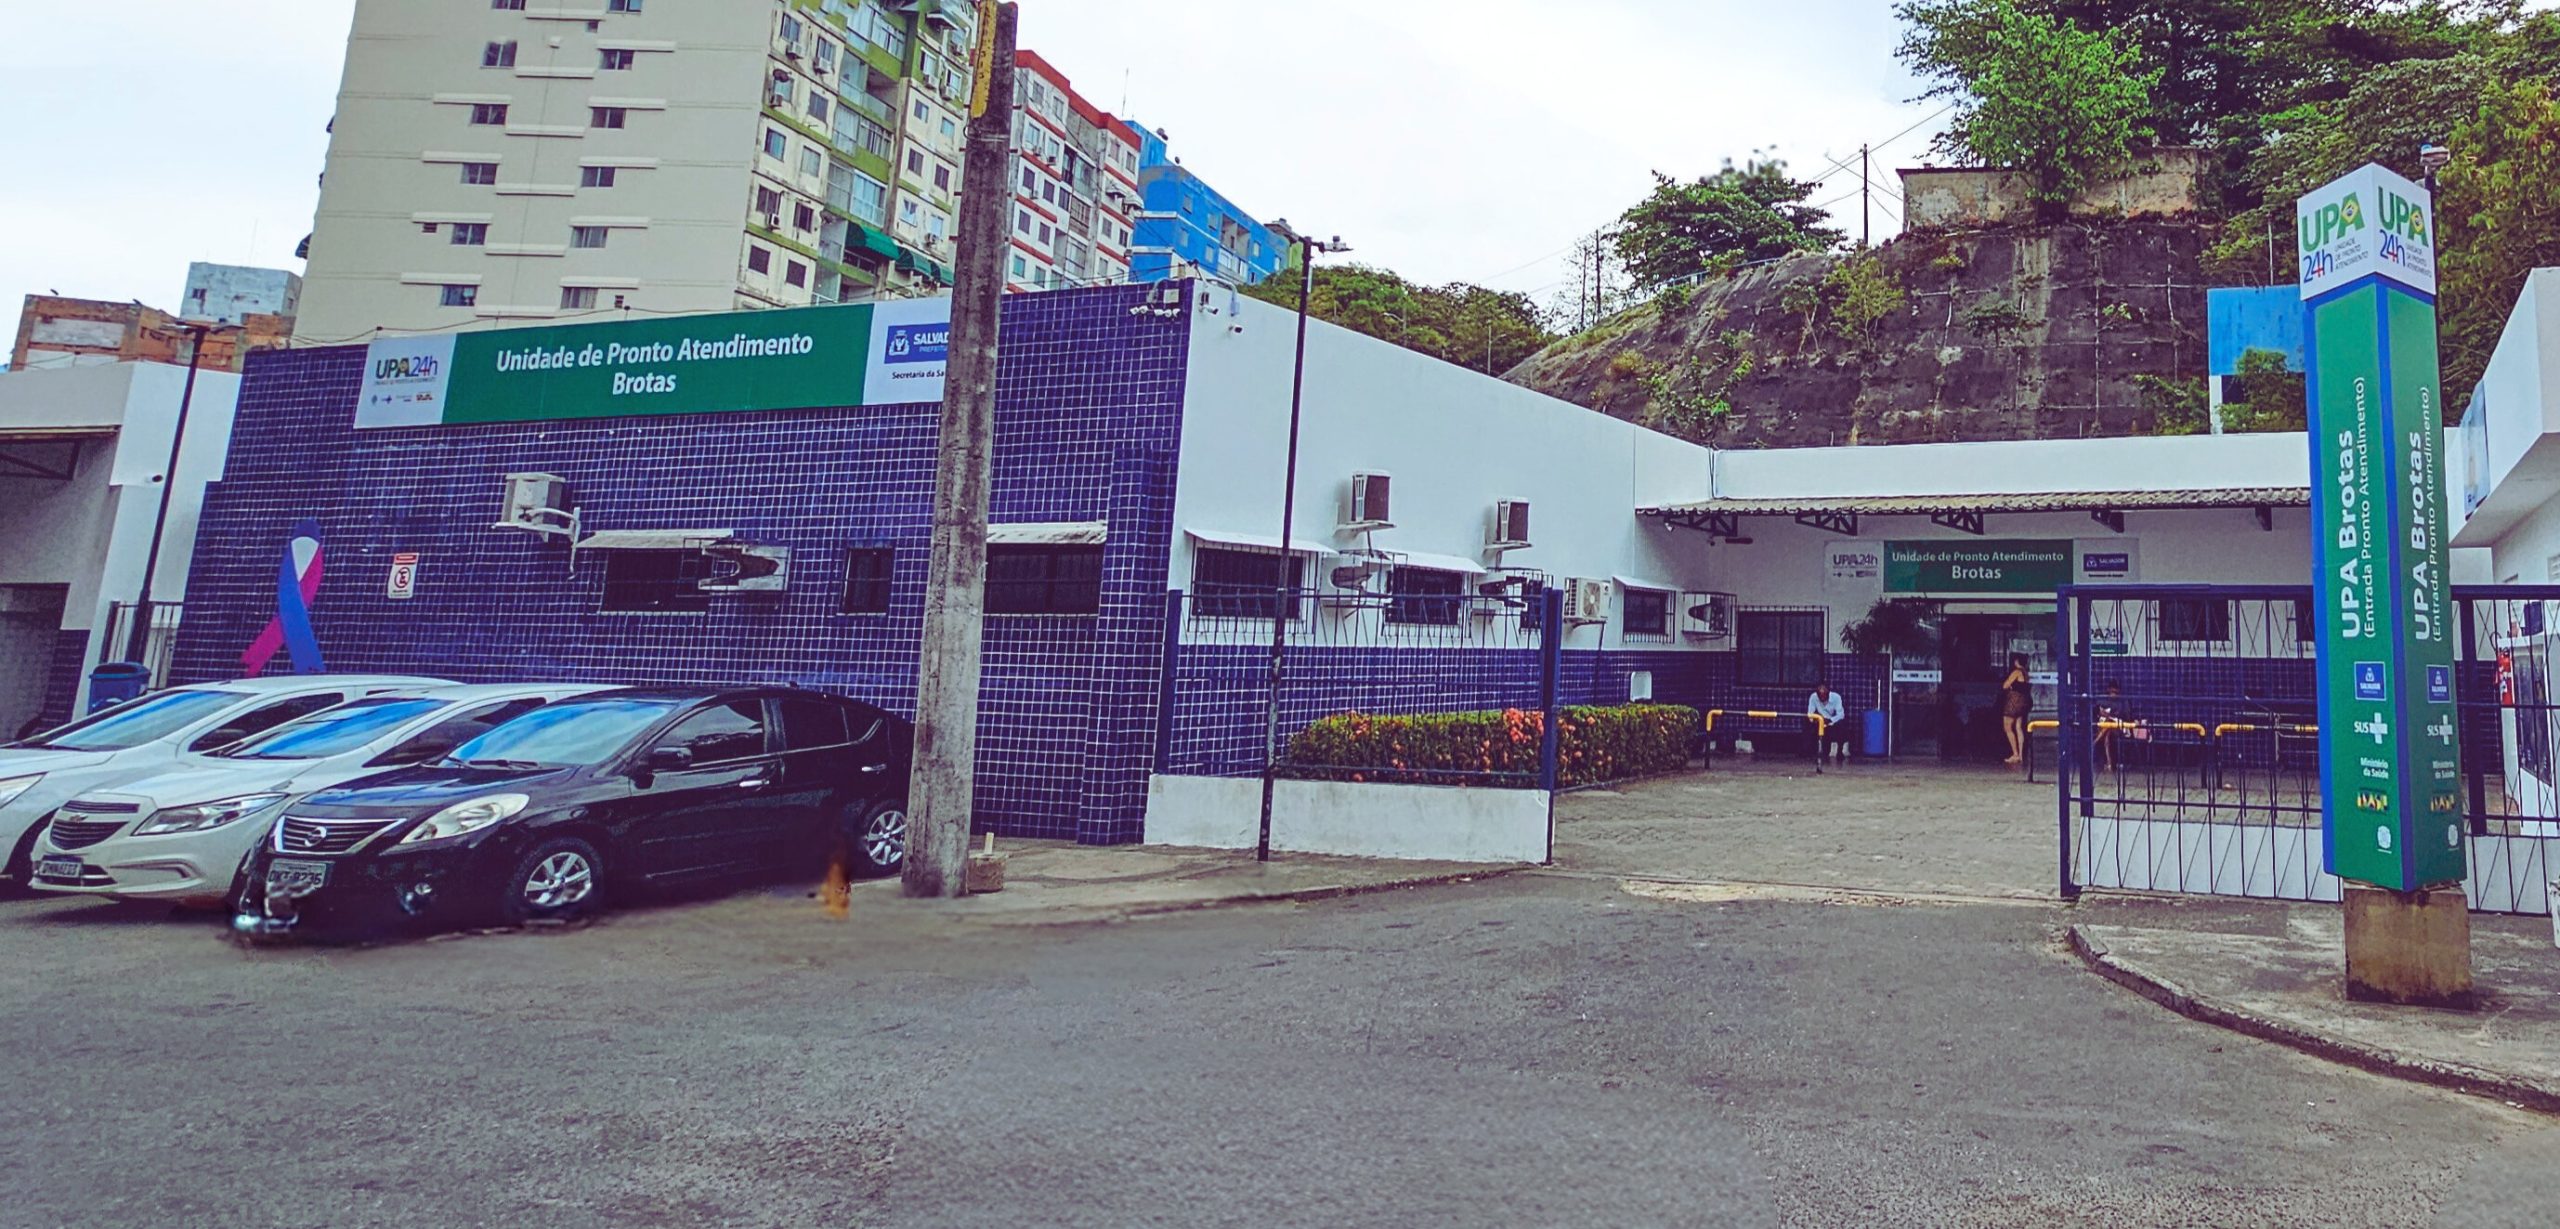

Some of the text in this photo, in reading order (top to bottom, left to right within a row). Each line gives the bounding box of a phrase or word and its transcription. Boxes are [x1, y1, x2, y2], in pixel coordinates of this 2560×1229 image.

[2302, 191, 2366, 252] UPA
[2378, 185, 2430, 248] UPA
[2303, 248, 2334, 284] 24h
[2379, 229, 2406, 267] 24h
[496, 333, 813, 372] Unidade de Pronto Atendimento
[613, 372, 677, 395] Brotas
[892, 370, 925, 379] Secretaria
[926, 370, 935, 378] da
[2353, 377, 2376, 638] (Entrada Pronto Atendimento)
[2420, 386, 2442, 642] (Entrada Pronto Atendimento)
[2338, 430, 2360, 638] UPA Brotas
[2409, 432, 2430, 640] UPA Brotas
[1892, 551, 2064, 562] Unidade de Pronto Atendimento
[1952, 565, 2002, 579] Brotas
[2354, 721, 2369, 733] SUS
